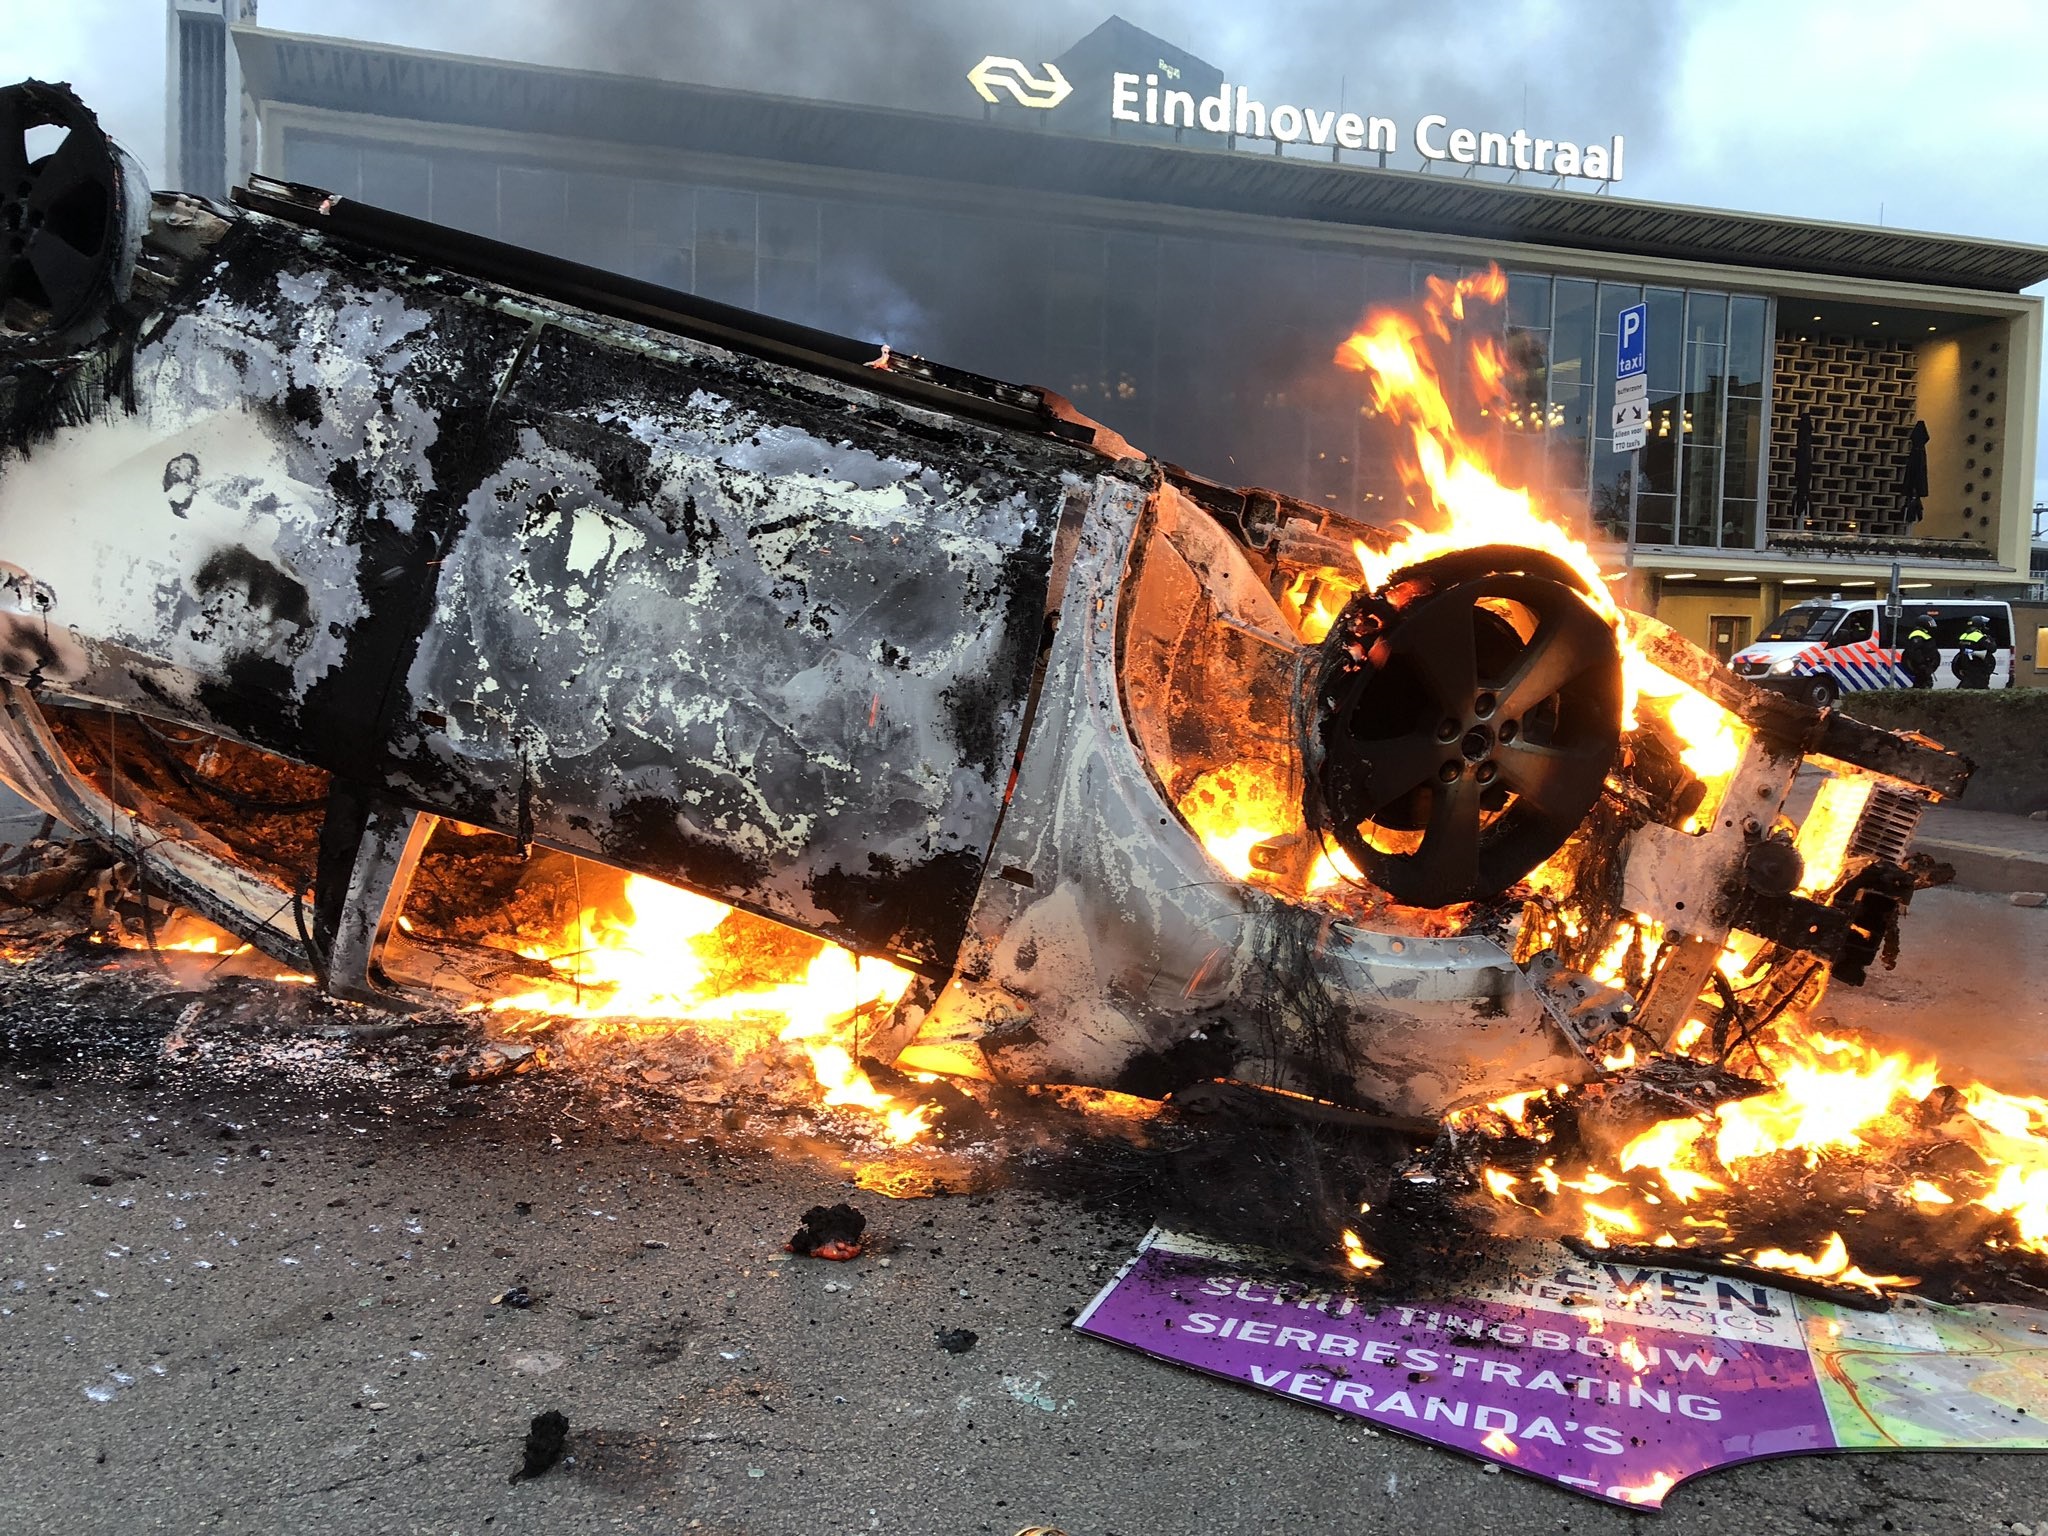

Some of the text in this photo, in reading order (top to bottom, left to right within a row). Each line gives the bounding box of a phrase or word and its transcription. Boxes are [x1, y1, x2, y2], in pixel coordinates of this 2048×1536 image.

[1111, 71, 1625, 181] Eindhoven Centraal
[1623, 311, 1640, 349] P
[1619, 353, 1642, 372] taxi
[1615, 427, 1642, 438] Alleen voor
[1180, 1312, 1722, 1421] SIERBESTRATING
